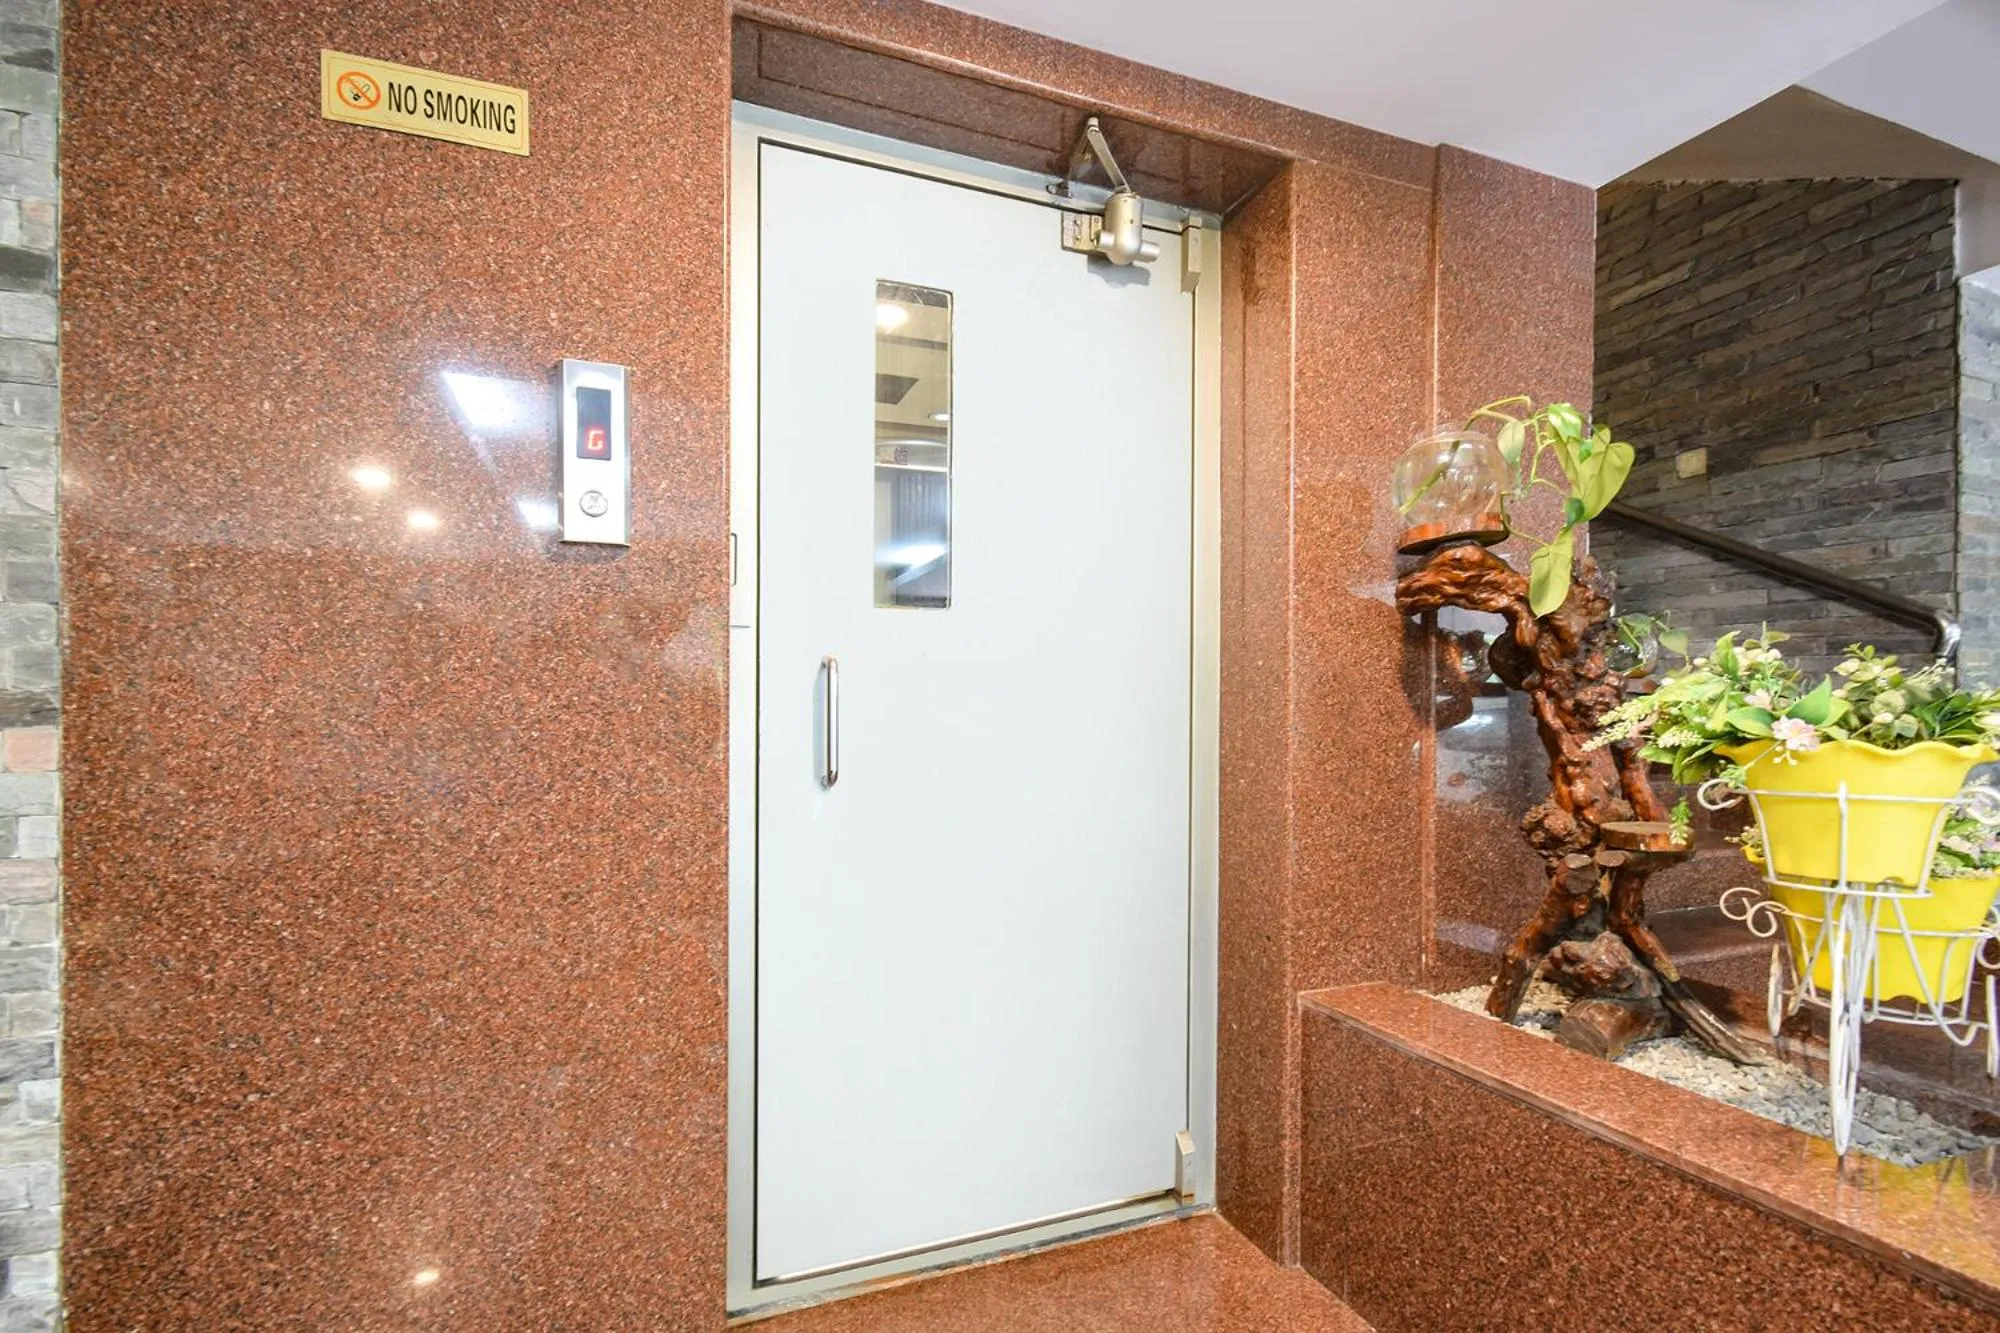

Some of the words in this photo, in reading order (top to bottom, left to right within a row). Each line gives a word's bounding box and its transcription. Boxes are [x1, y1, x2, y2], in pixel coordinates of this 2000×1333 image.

[388, 81, 417, 115] NO
[423, 88, 516, 134] SMOKING
[586, 429, 605, 451] G
